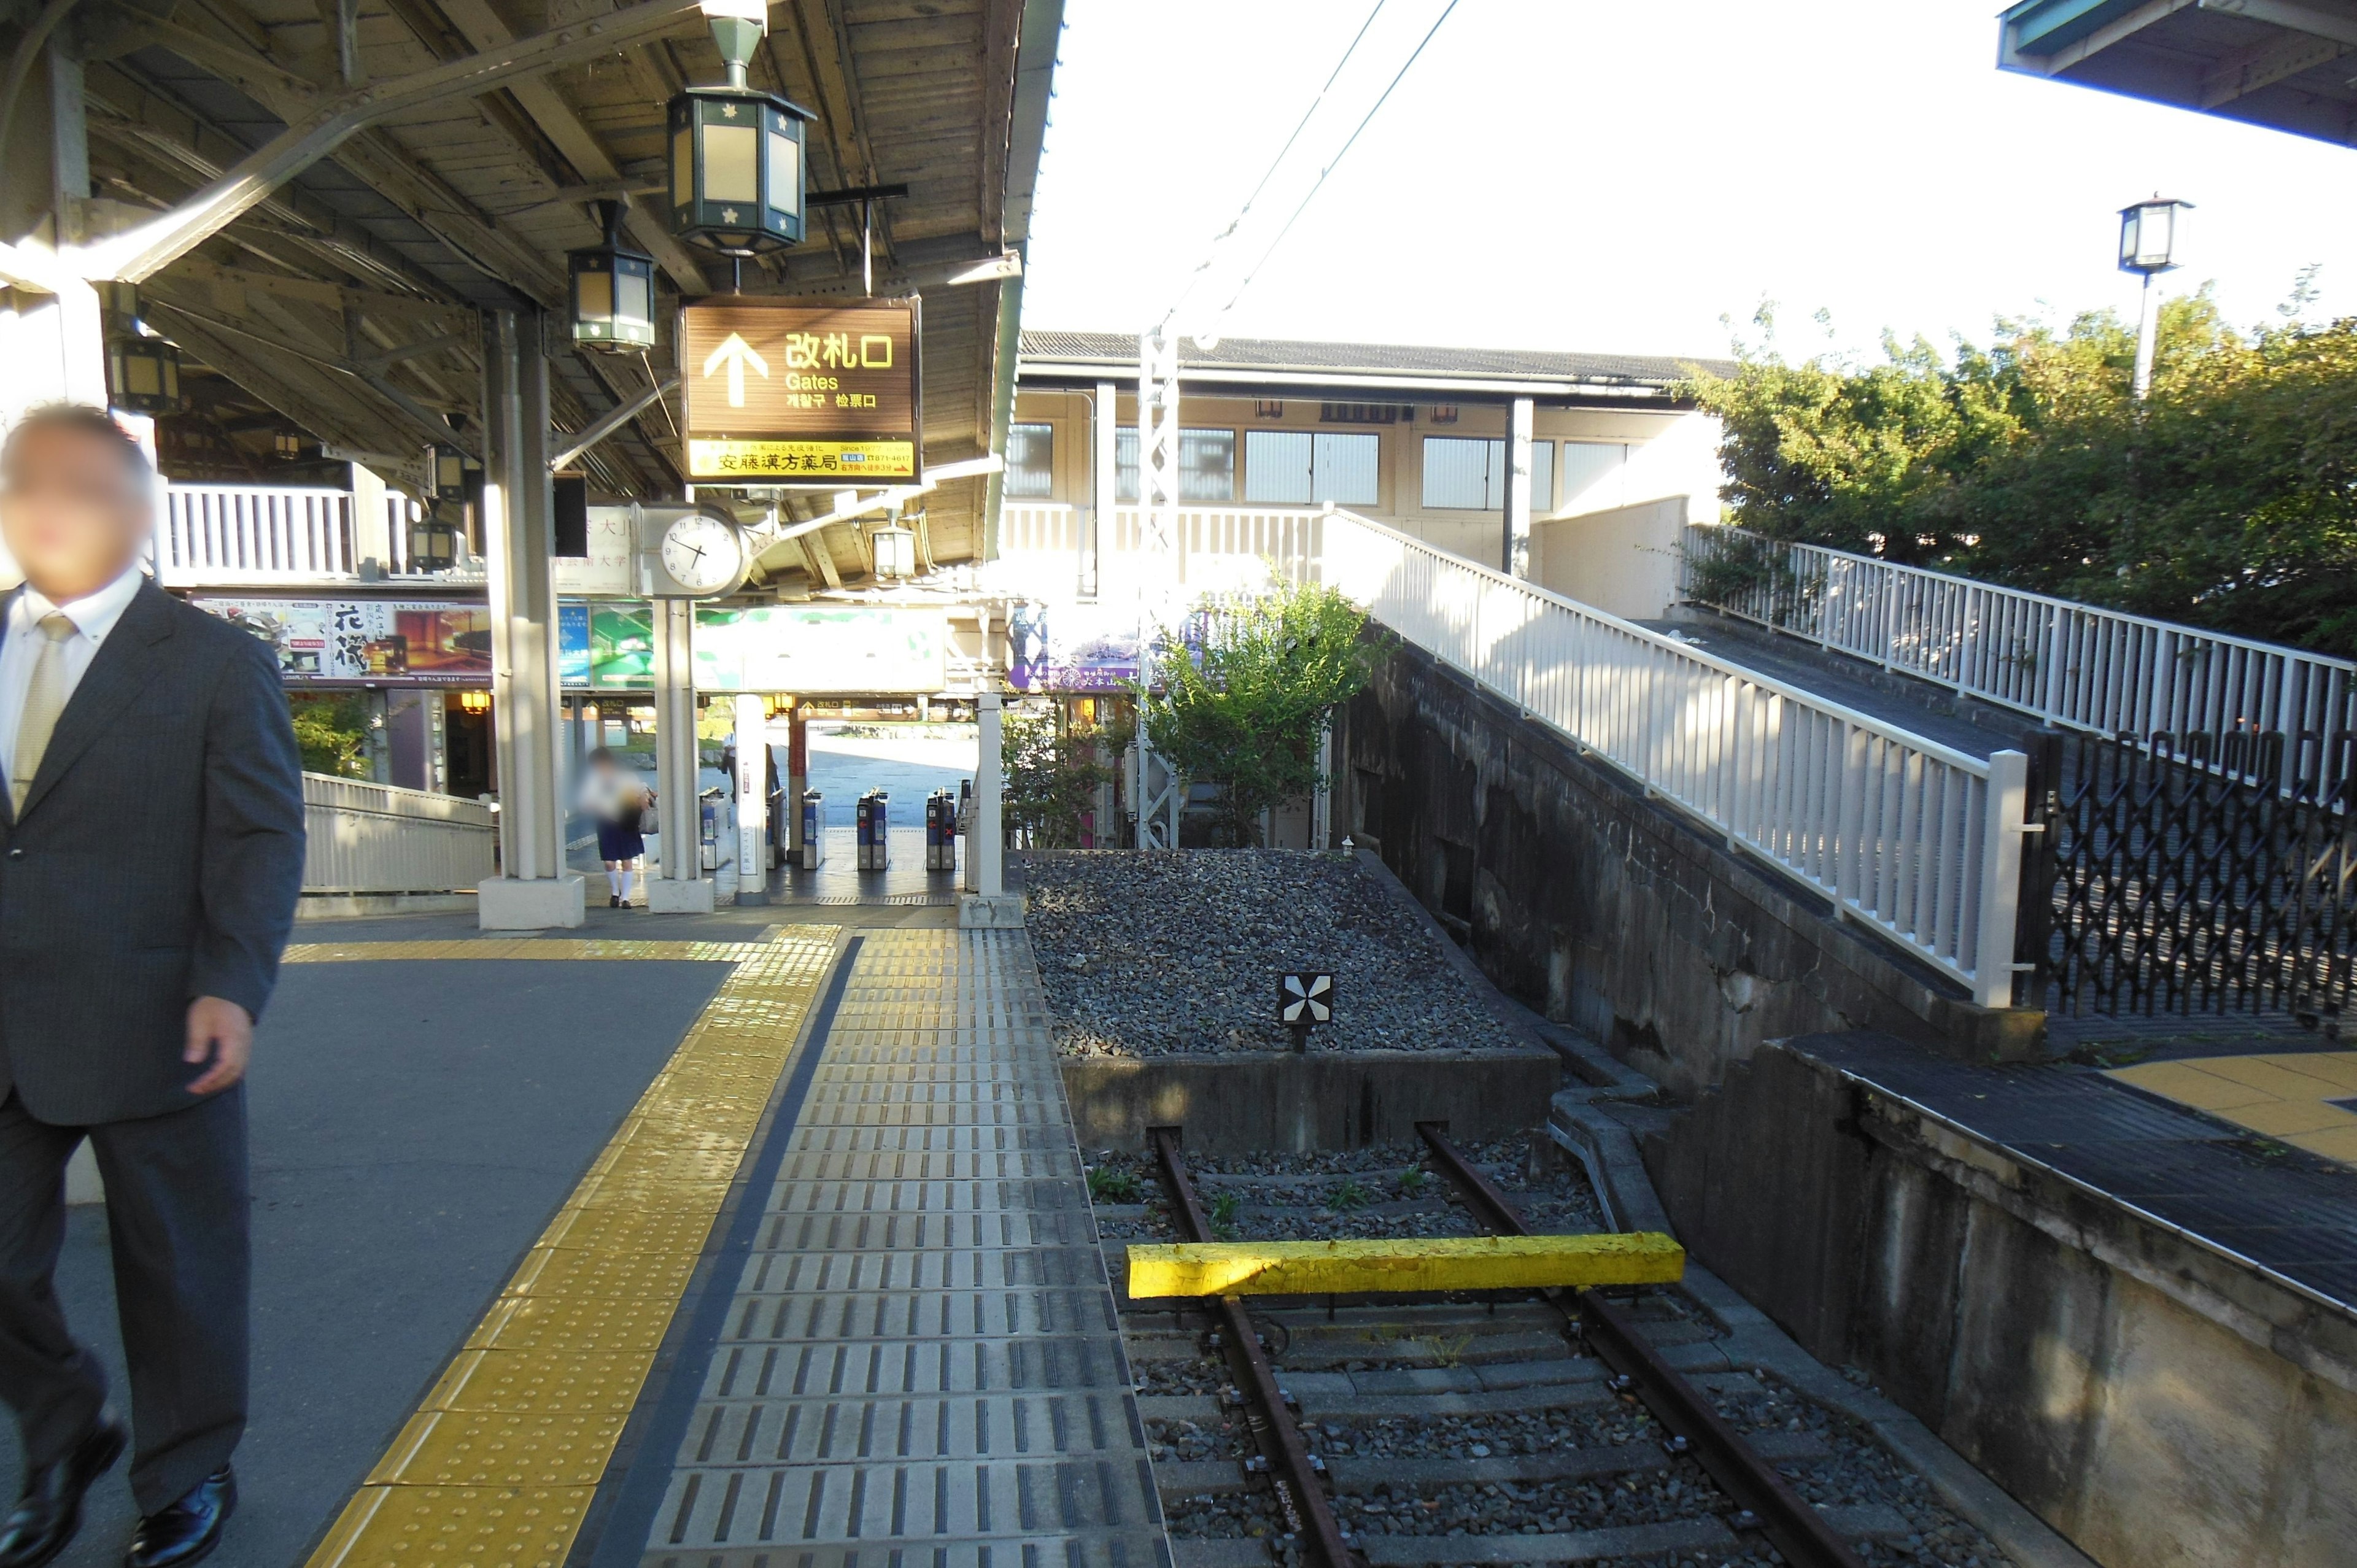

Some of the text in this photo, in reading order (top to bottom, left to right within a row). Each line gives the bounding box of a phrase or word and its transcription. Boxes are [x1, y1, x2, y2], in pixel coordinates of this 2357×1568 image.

[785, 333, 893, 369] 改札口
[785, 373, 839, 391] Gates
[786, 393, 826, 409] 개찰구
[835, 393, 877, 408] 检票口
[718, 454, 838, 471] 安藤漢方薬局
[695, 517, 702, 525] 12
[670, 562, 676, 571] 8
